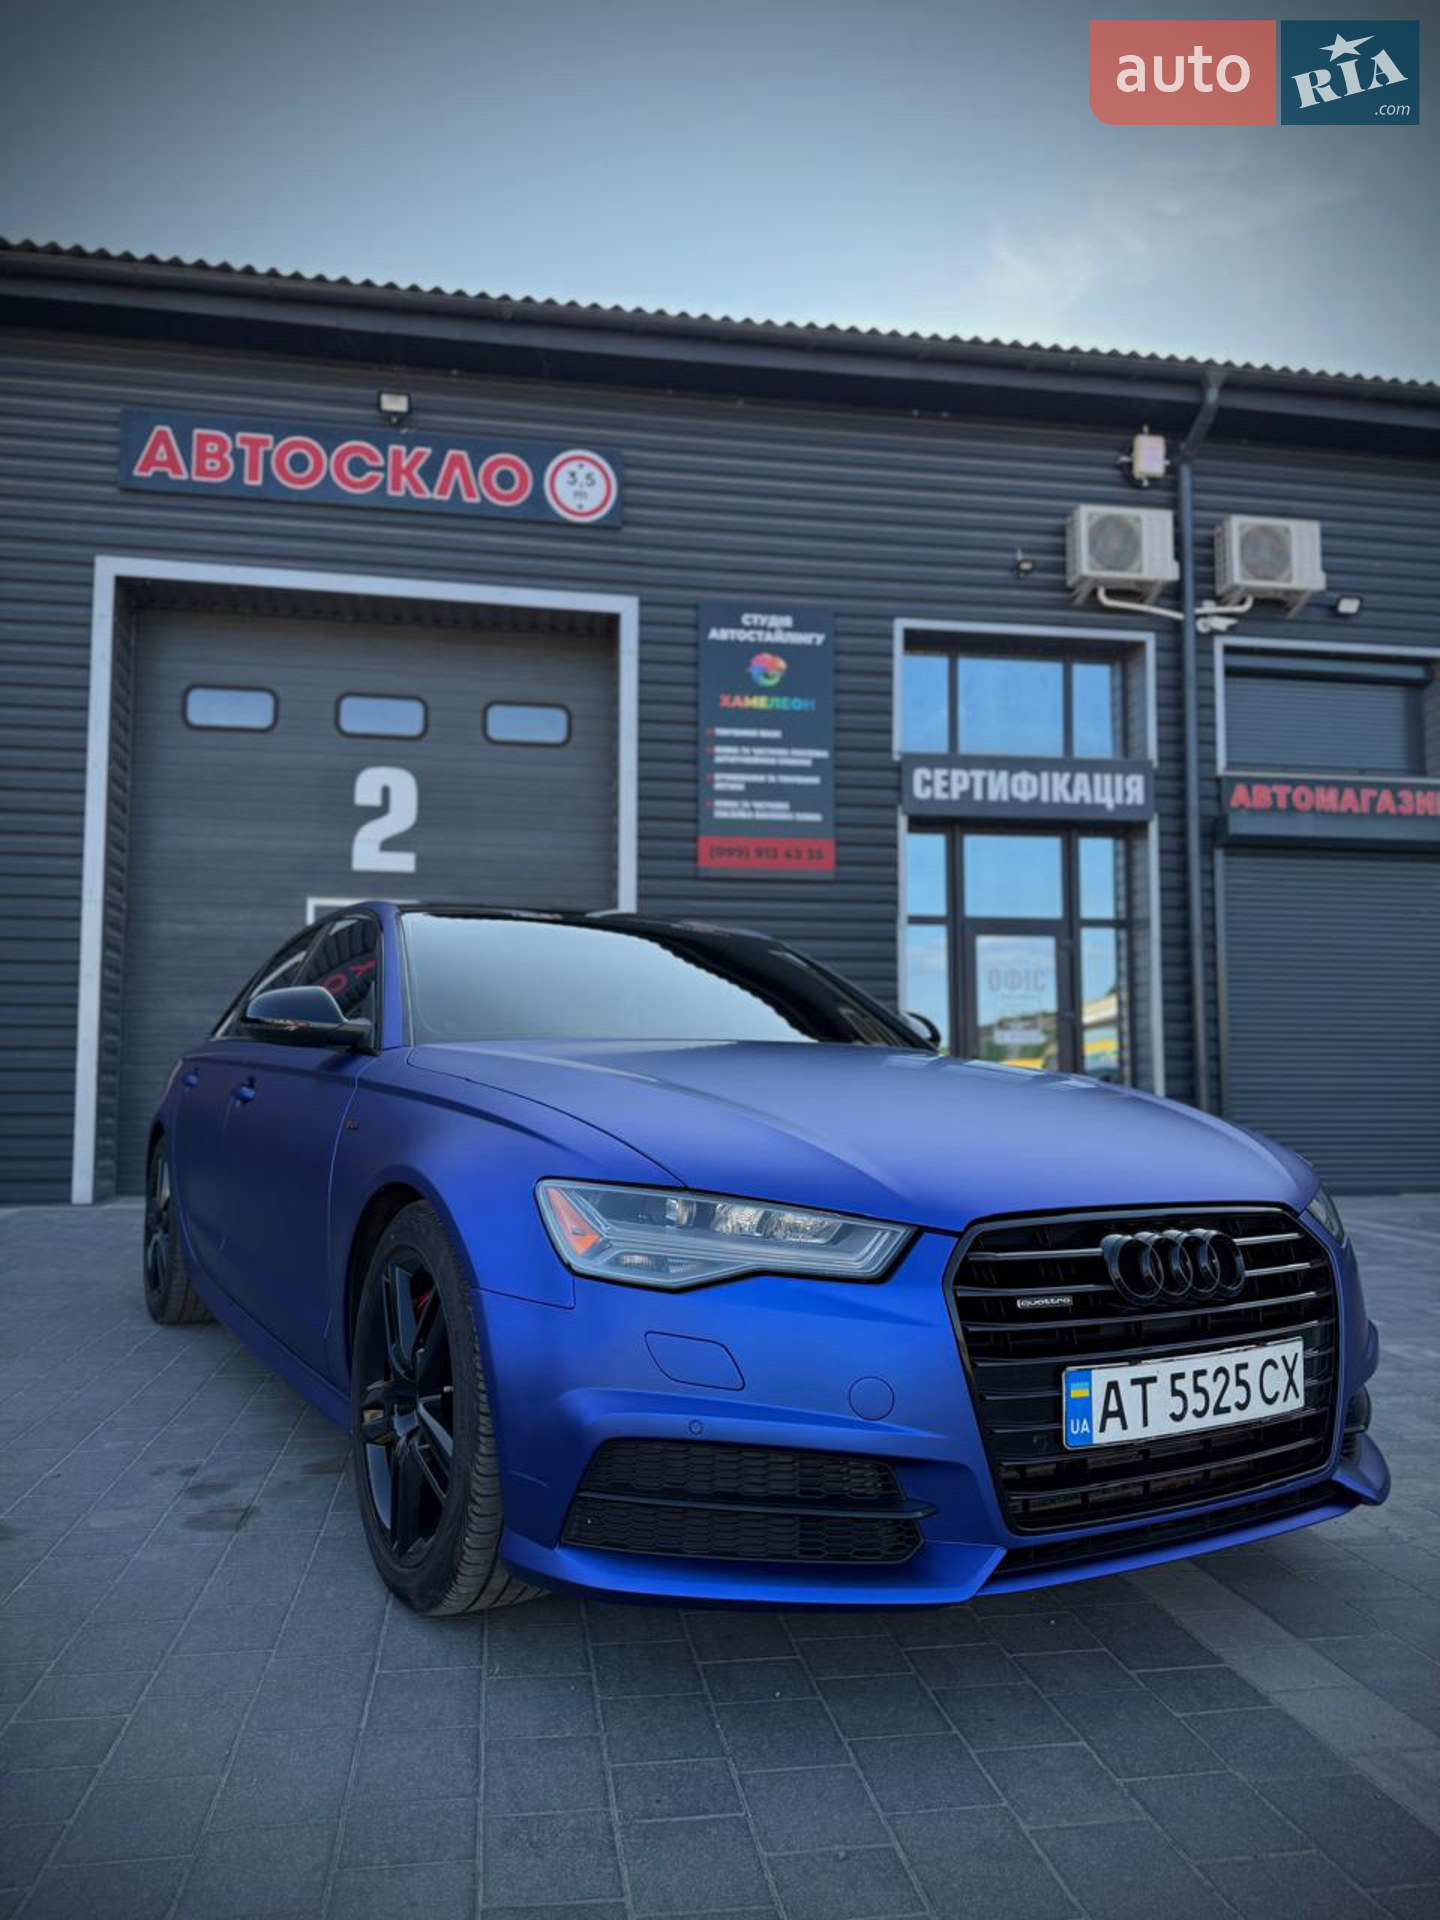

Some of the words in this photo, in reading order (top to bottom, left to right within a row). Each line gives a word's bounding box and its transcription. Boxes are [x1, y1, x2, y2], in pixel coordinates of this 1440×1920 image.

[133, 425, 533, 507] АВТОСКЛО
[720, 694, 817, 712] ХАМЕЛЕОН
[912, 766, 1146, 811] СЕРТИФІКАЦІЯ
[1230, 782, 1440, 818] АВТОМАГАЗИ
[352, 766, 418, 873] 2
[1099, 1376, 1158, 1433] AT
[1169, 1362, 1251, 1423] 5525
[1259, 1352, 1300, 1406] CX
[1070, 1418, 1090, 1435] UA
